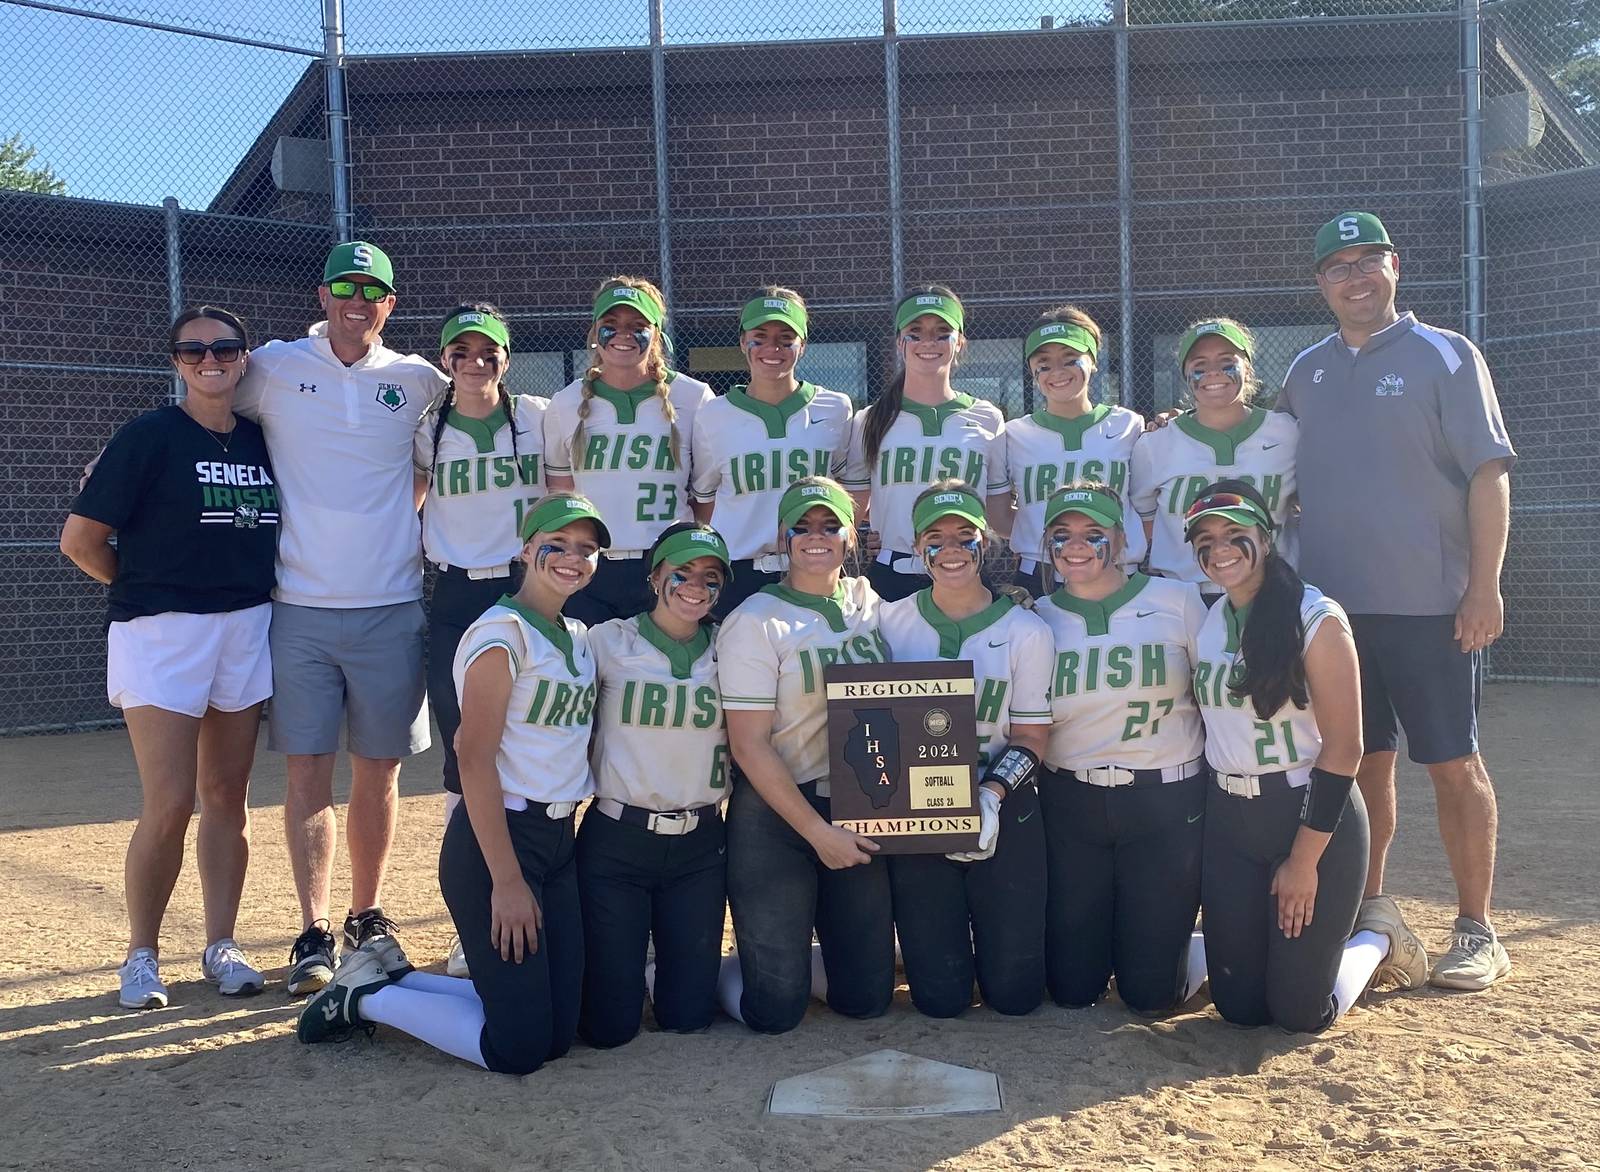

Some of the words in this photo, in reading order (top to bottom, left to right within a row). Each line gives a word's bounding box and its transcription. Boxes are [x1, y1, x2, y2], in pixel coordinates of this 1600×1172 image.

[1338, 217, 1360, 241] S
[353, 246, 373, 268] S
[584, 434, 677, 470] RISH
[881, 447, 983, 488] IRISH
[196, 461, 273, 486] SENECA
[437, 454, 538, 496] IRISH
[731, 449, 830, 495] IRISH
[202, 486, 278, 508] IRISH
[637, 483, 677, 521] 23
[1169, 474, 1282, 514] IRH
[844, 681, 958, 697] REGIONAL
[1055, 644, 1167, 698] RISH
[526, 679, 596, 727] IRIS
[621, 681, 726, 729] IRIS
[1121, 698, 1174, 742] 27
[918, 744, 959, 759] 2024
[1254, 720, 1298, 766] 21
[924, 776, 955, 787] SOFTBALL
[926, 798, 945, 807] CLASS
[947, 798, 955, 806] 2A
